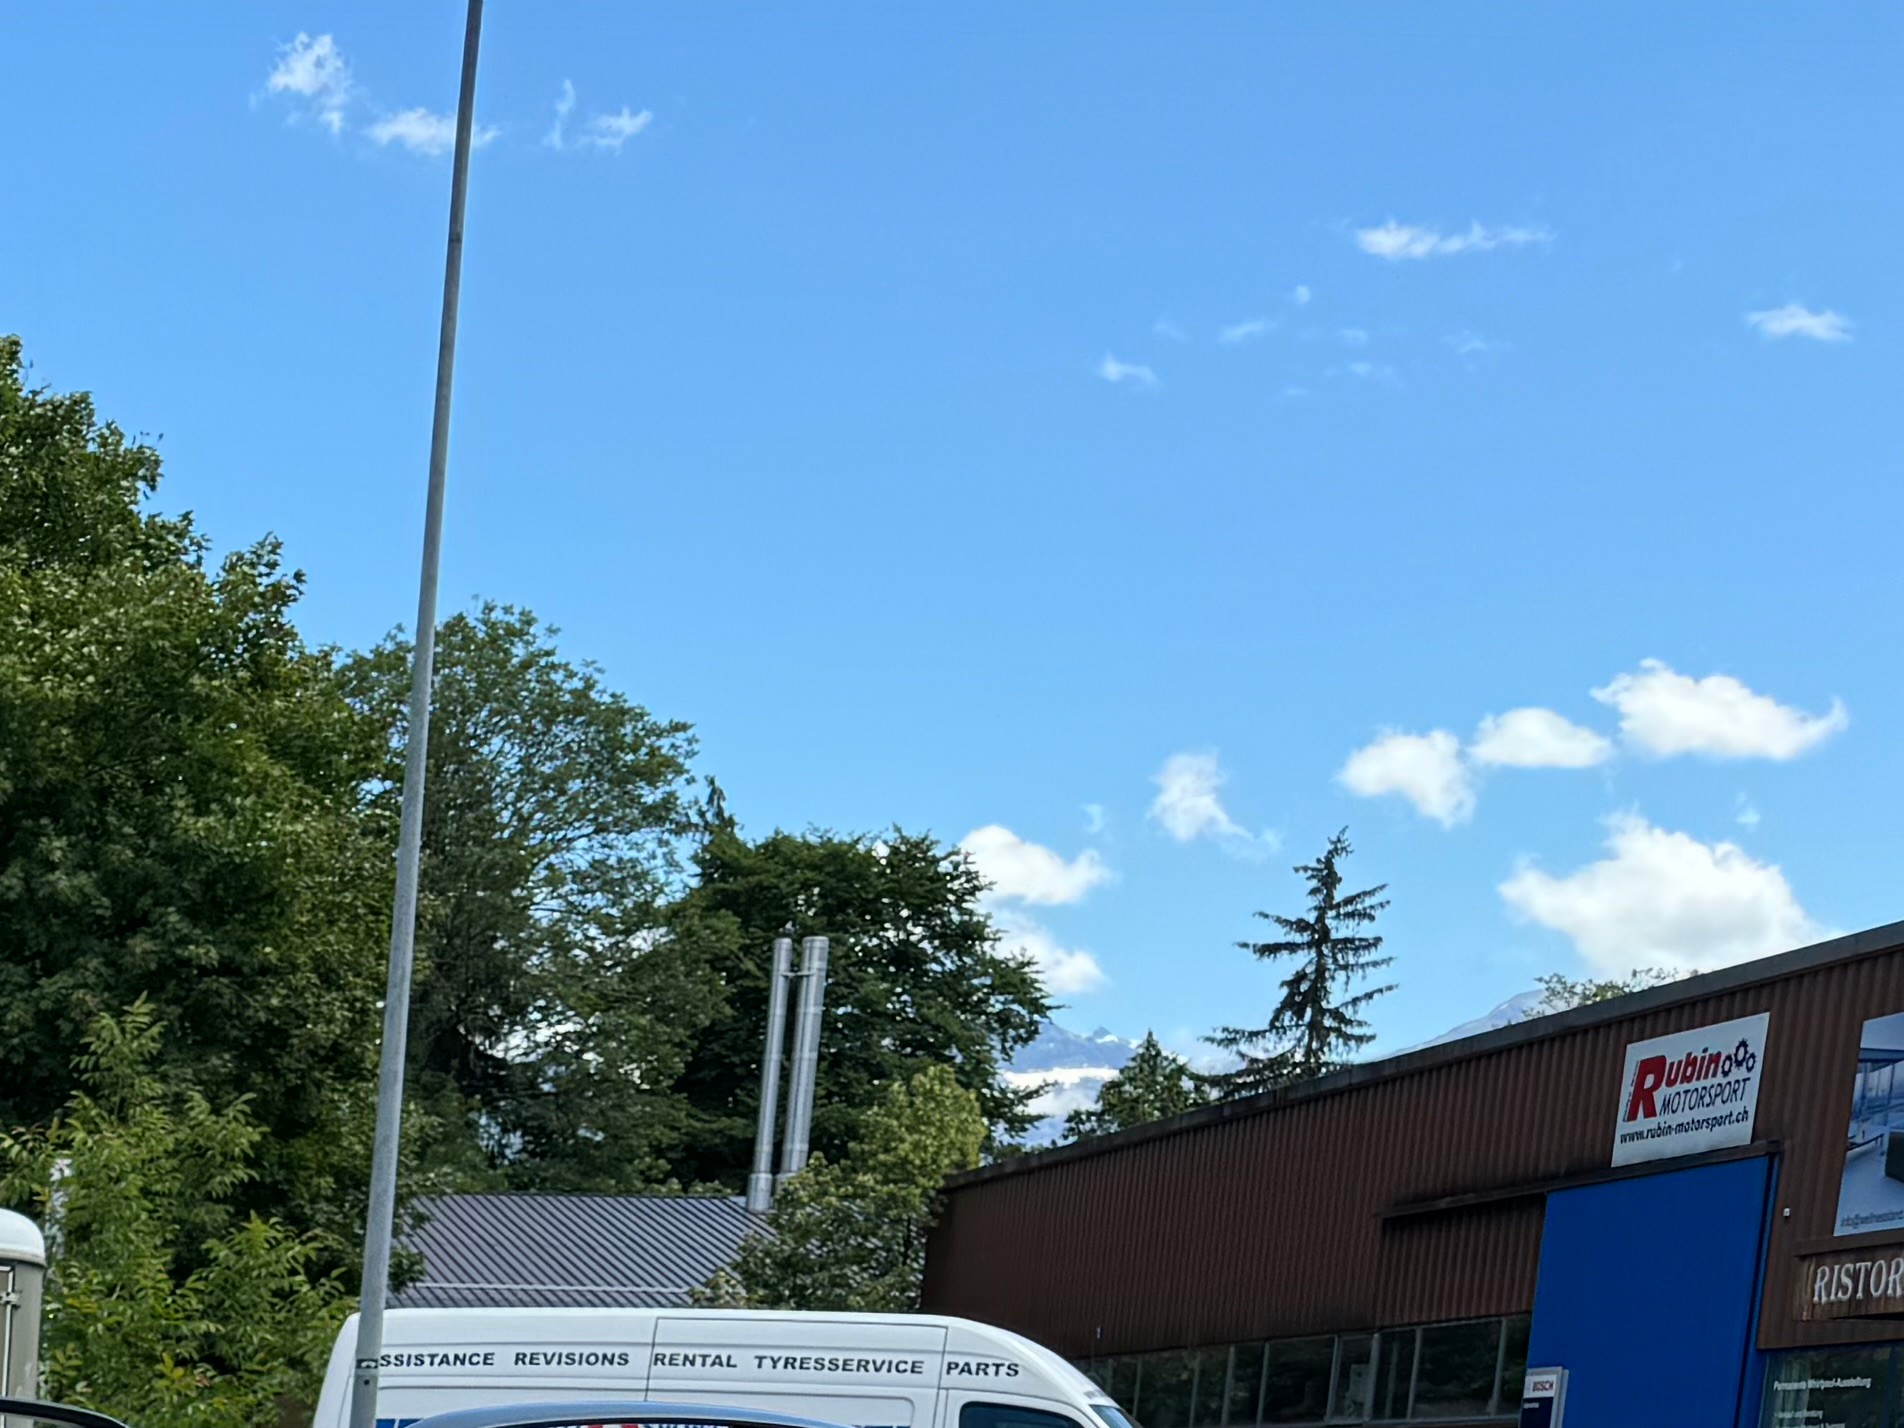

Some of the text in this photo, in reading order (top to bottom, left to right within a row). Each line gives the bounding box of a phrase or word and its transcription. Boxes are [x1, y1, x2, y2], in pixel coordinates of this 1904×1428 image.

[1623, 1047, 1723, 1122] Rubin
[1659, 1077, 1751, 1117] MOTORSPORT
[1620, 1106, 1749, 1144] www.rubin-motorsport.ch
[379, 1352, 1021, 1378] SSISTANCE REVISIONS RENTAL TYRESSERVICE PARTS
